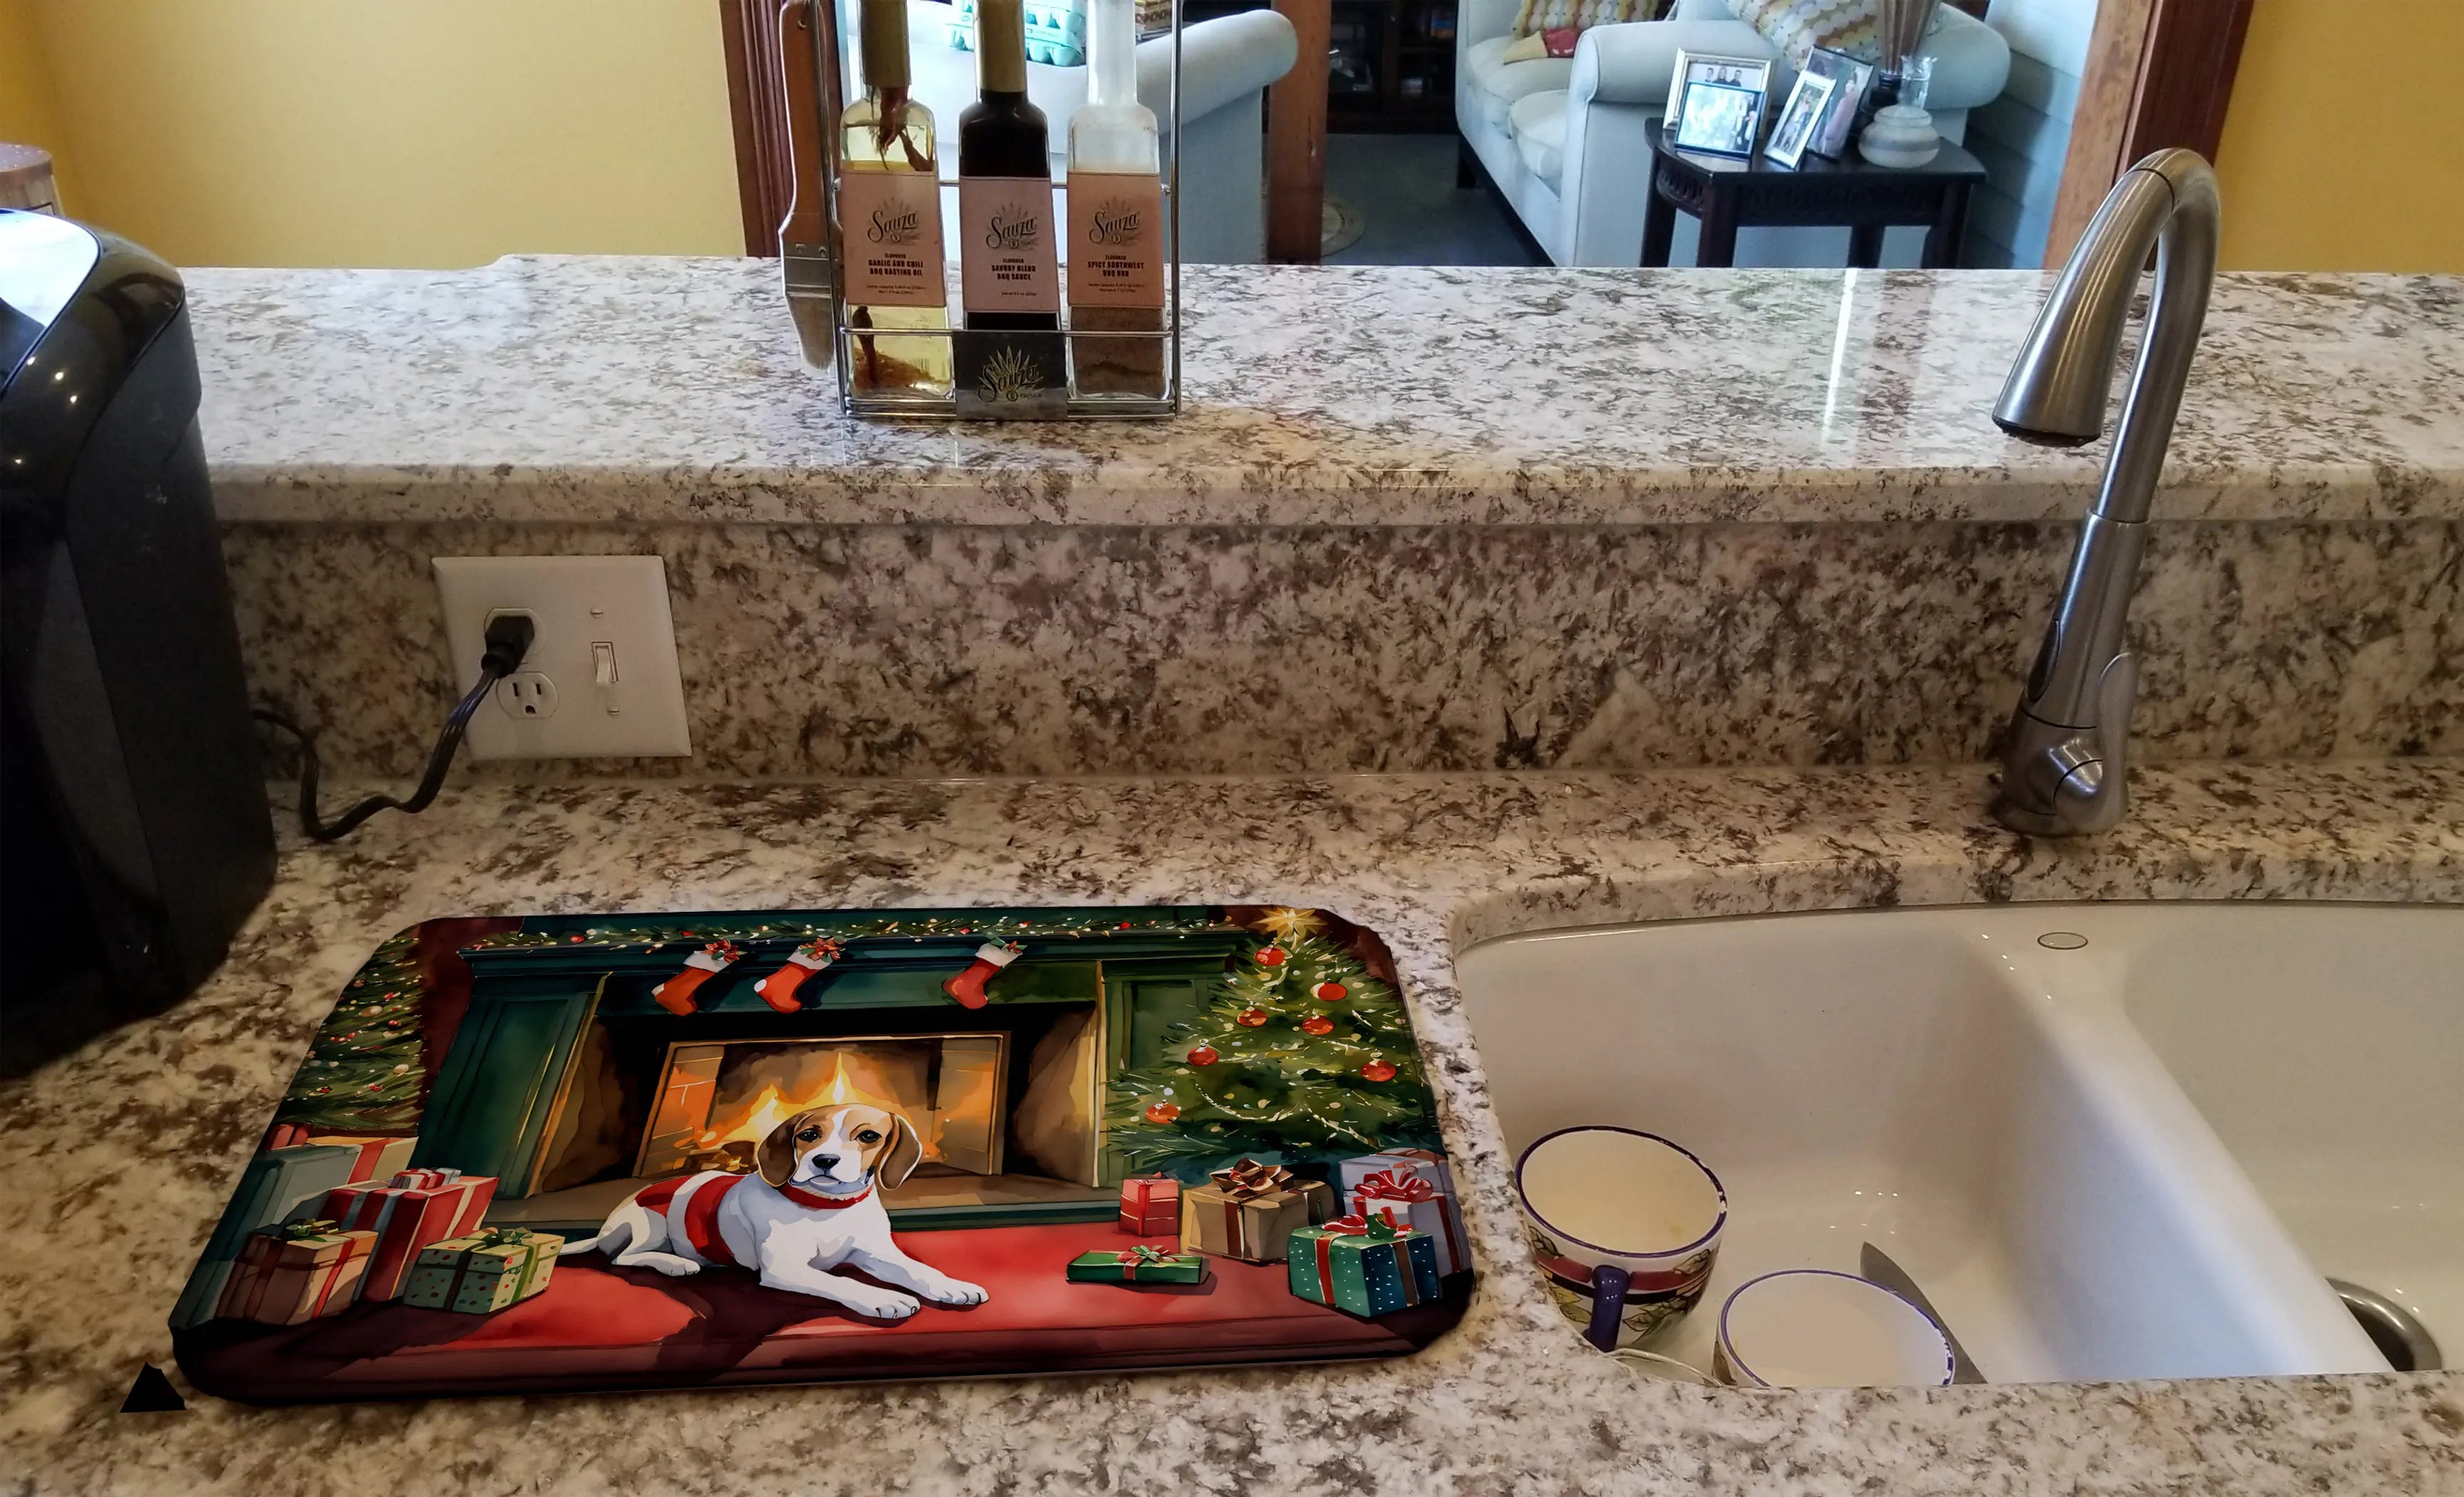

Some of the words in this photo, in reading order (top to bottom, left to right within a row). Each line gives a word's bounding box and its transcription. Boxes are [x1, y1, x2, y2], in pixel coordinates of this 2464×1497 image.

[867, 210, 918, 243] Sauza
[986, 216, 1037, 249] Sauza
[1089, 211, 1140, 244] Sauza
[977, 364, 1043, 403] Sauza
